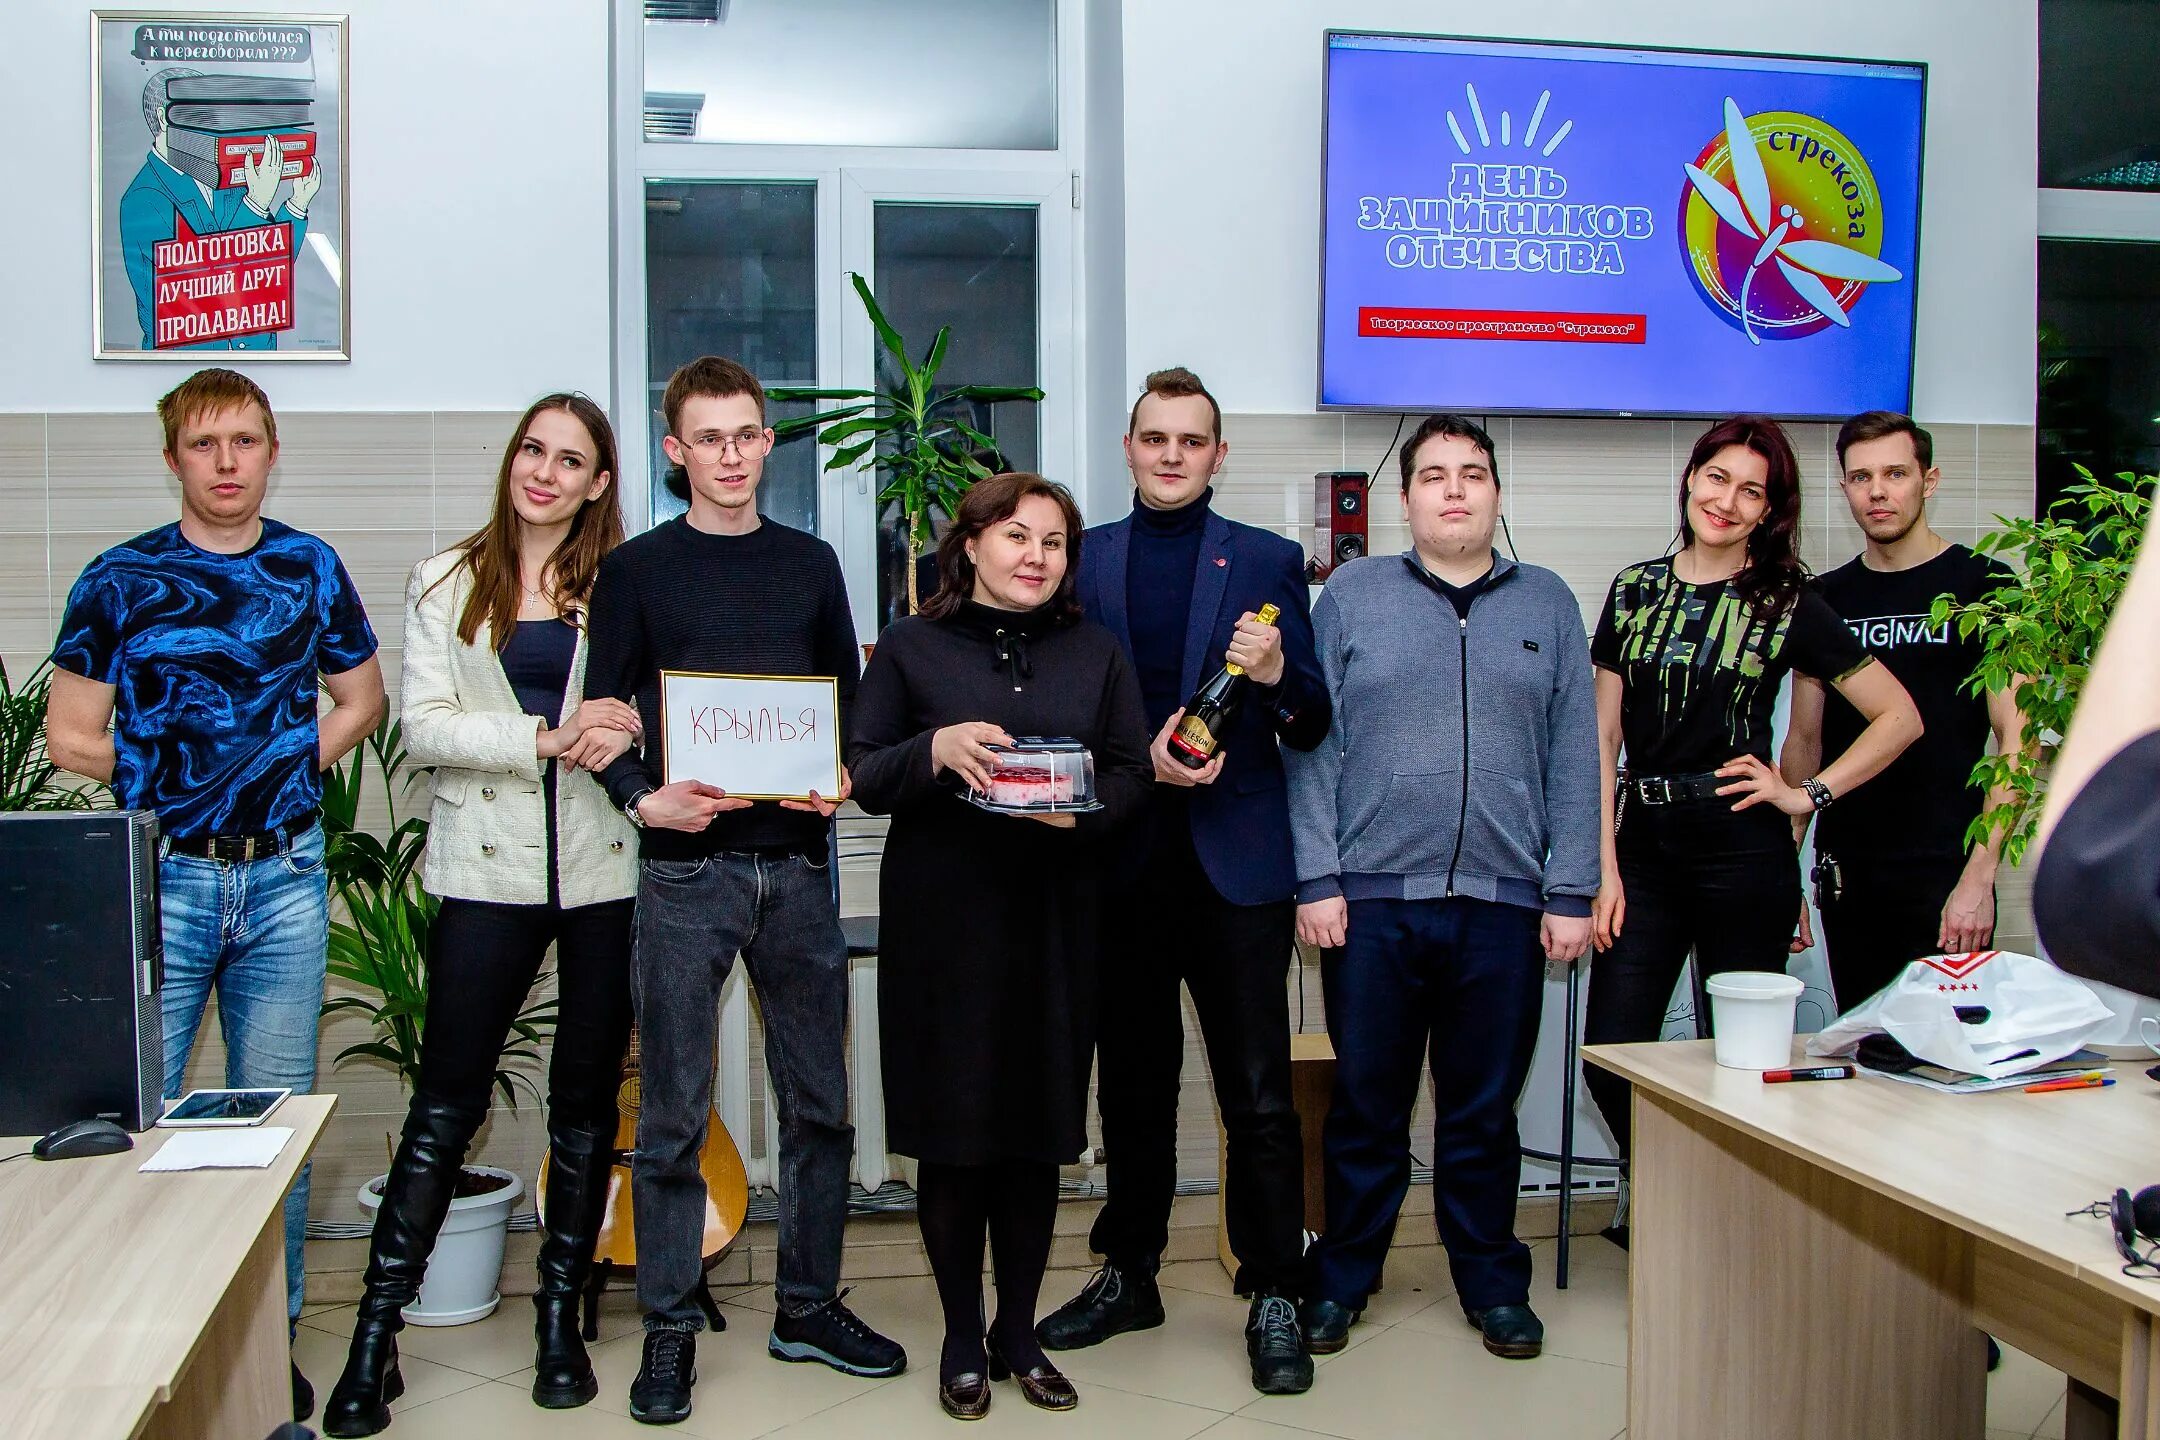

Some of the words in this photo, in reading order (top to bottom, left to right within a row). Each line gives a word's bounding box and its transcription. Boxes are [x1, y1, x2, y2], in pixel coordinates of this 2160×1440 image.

[143, 28, 155, 41] А
[158, 28, 184, 42] ты
[188, 28, 304, 45] подготовился
[150, 45, 159, 58] к
[1449, 163, 1567, 202] ДЕНЬ
[1768, 131, 1866, 240] стрекоза
[1357, 196, 1653, 239] ЗАЩИТНИКОВ
[158, 228, 285, 268] ПОДГОТОВКА
[1386, 234, 1625, 275] ОТЕЧЕСТВА
[158, 271, 235, 304] ЛУЧШИЙ
[241, 265, 286, 291] ДРУГ
[159, 300, 286, 342] ПРОДАВАНА!
[1370, 317, 1454, 331] Творческое
[1456, 320, 1555, 335] пространство
[1557, 321, 1635, 336] "Стрекоза"
[690, 706, 816, 744] КРЫЛЬЯ
